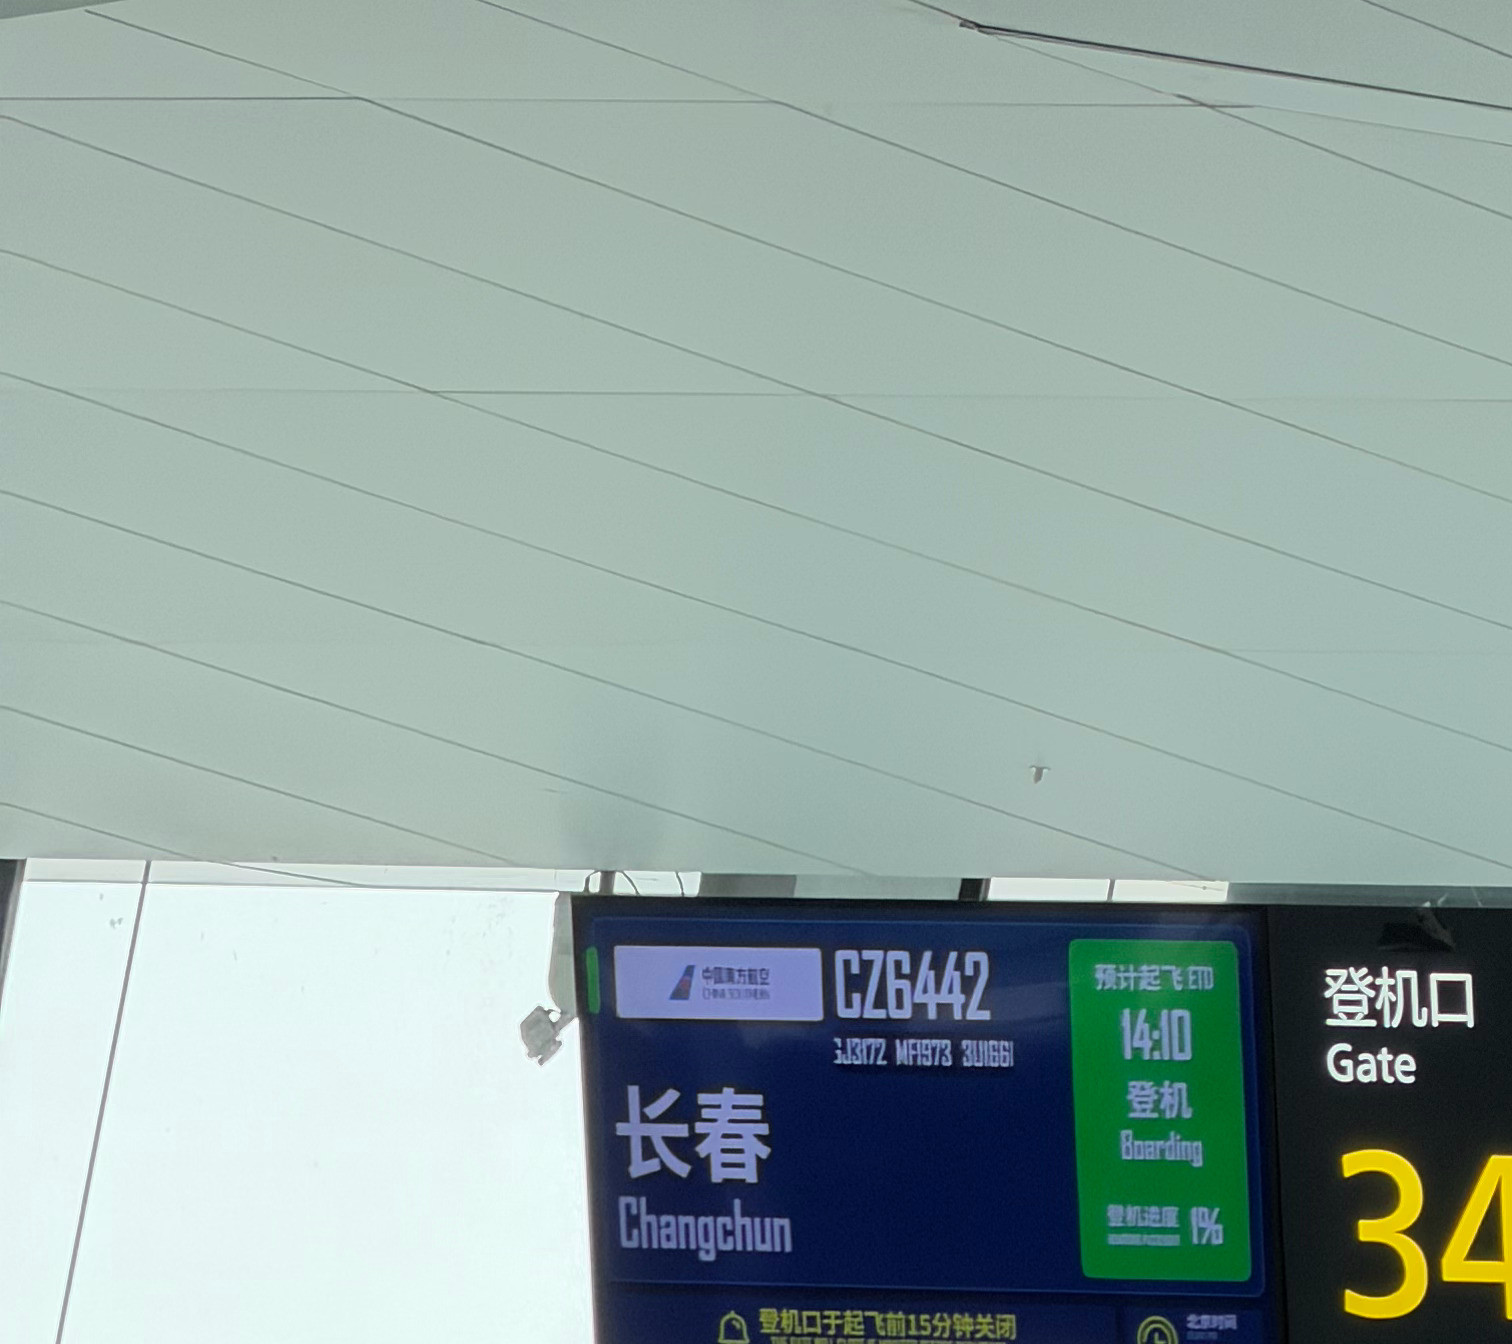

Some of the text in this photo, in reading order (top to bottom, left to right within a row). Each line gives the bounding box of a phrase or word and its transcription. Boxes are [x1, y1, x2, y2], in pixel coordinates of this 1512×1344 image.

[834, 948, 992, 1020] CZ6442
[1095, 964, 1214, 991] 预计起飞 ETD
[1323, 966, 1475, 1029] 登机口
[1121, 1007, 1192, 1061] 14:10
[1325, 1042, 1417, 1084] Gate
[1127, 1079, 1193, 1119] 登机
[615, 1083, 772, 1184] 长春
[1119, 1129, 1204, 1168] Boarding
[618, 1196, 793, 1262] Changchun
[1107, 1204, 1180, 1228] 登机进度
[1190, 1205, 1224, 1246] 1%
[759, 1308, 1016, 1341] 登机口于起飞前15分钟关闭
